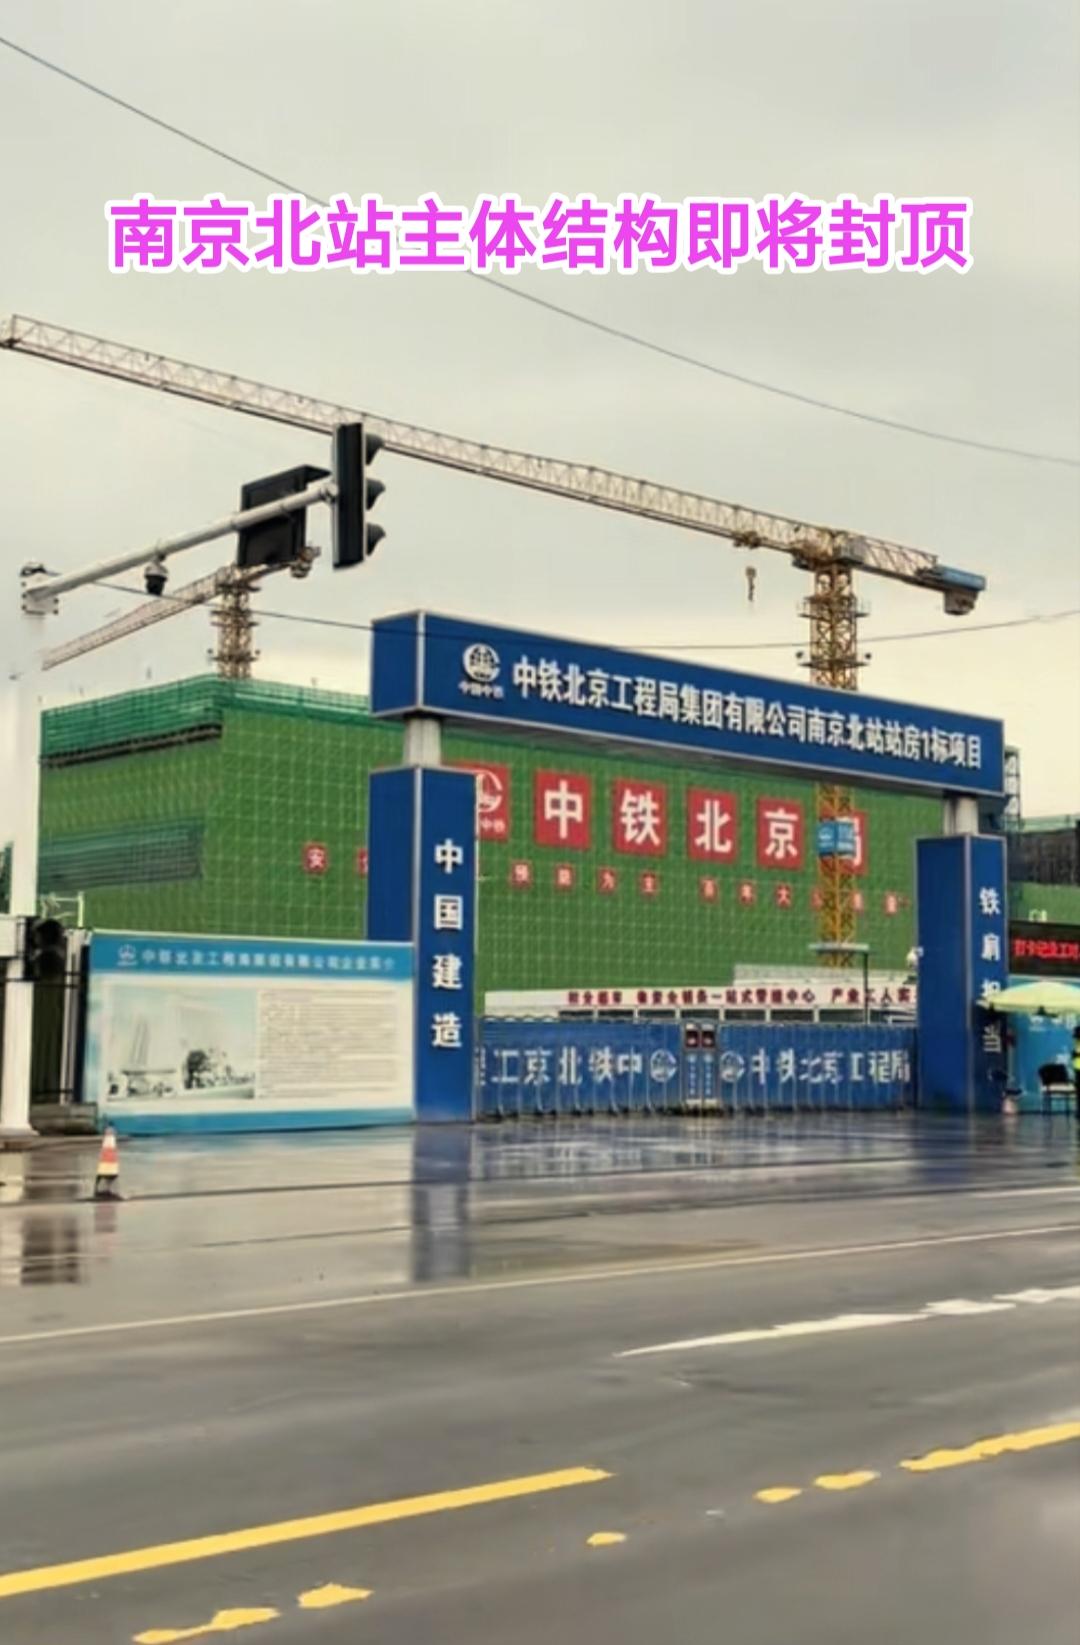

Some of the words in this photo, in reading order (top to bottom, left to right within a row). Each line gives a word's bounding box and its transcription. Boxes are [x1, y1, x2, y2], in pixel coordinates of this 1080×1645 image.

[513, 654, 983, 772] 中铁北京工程局集团有限公司南京北站站房1标项目
[432, 838, 464, 1050] 中国建造
